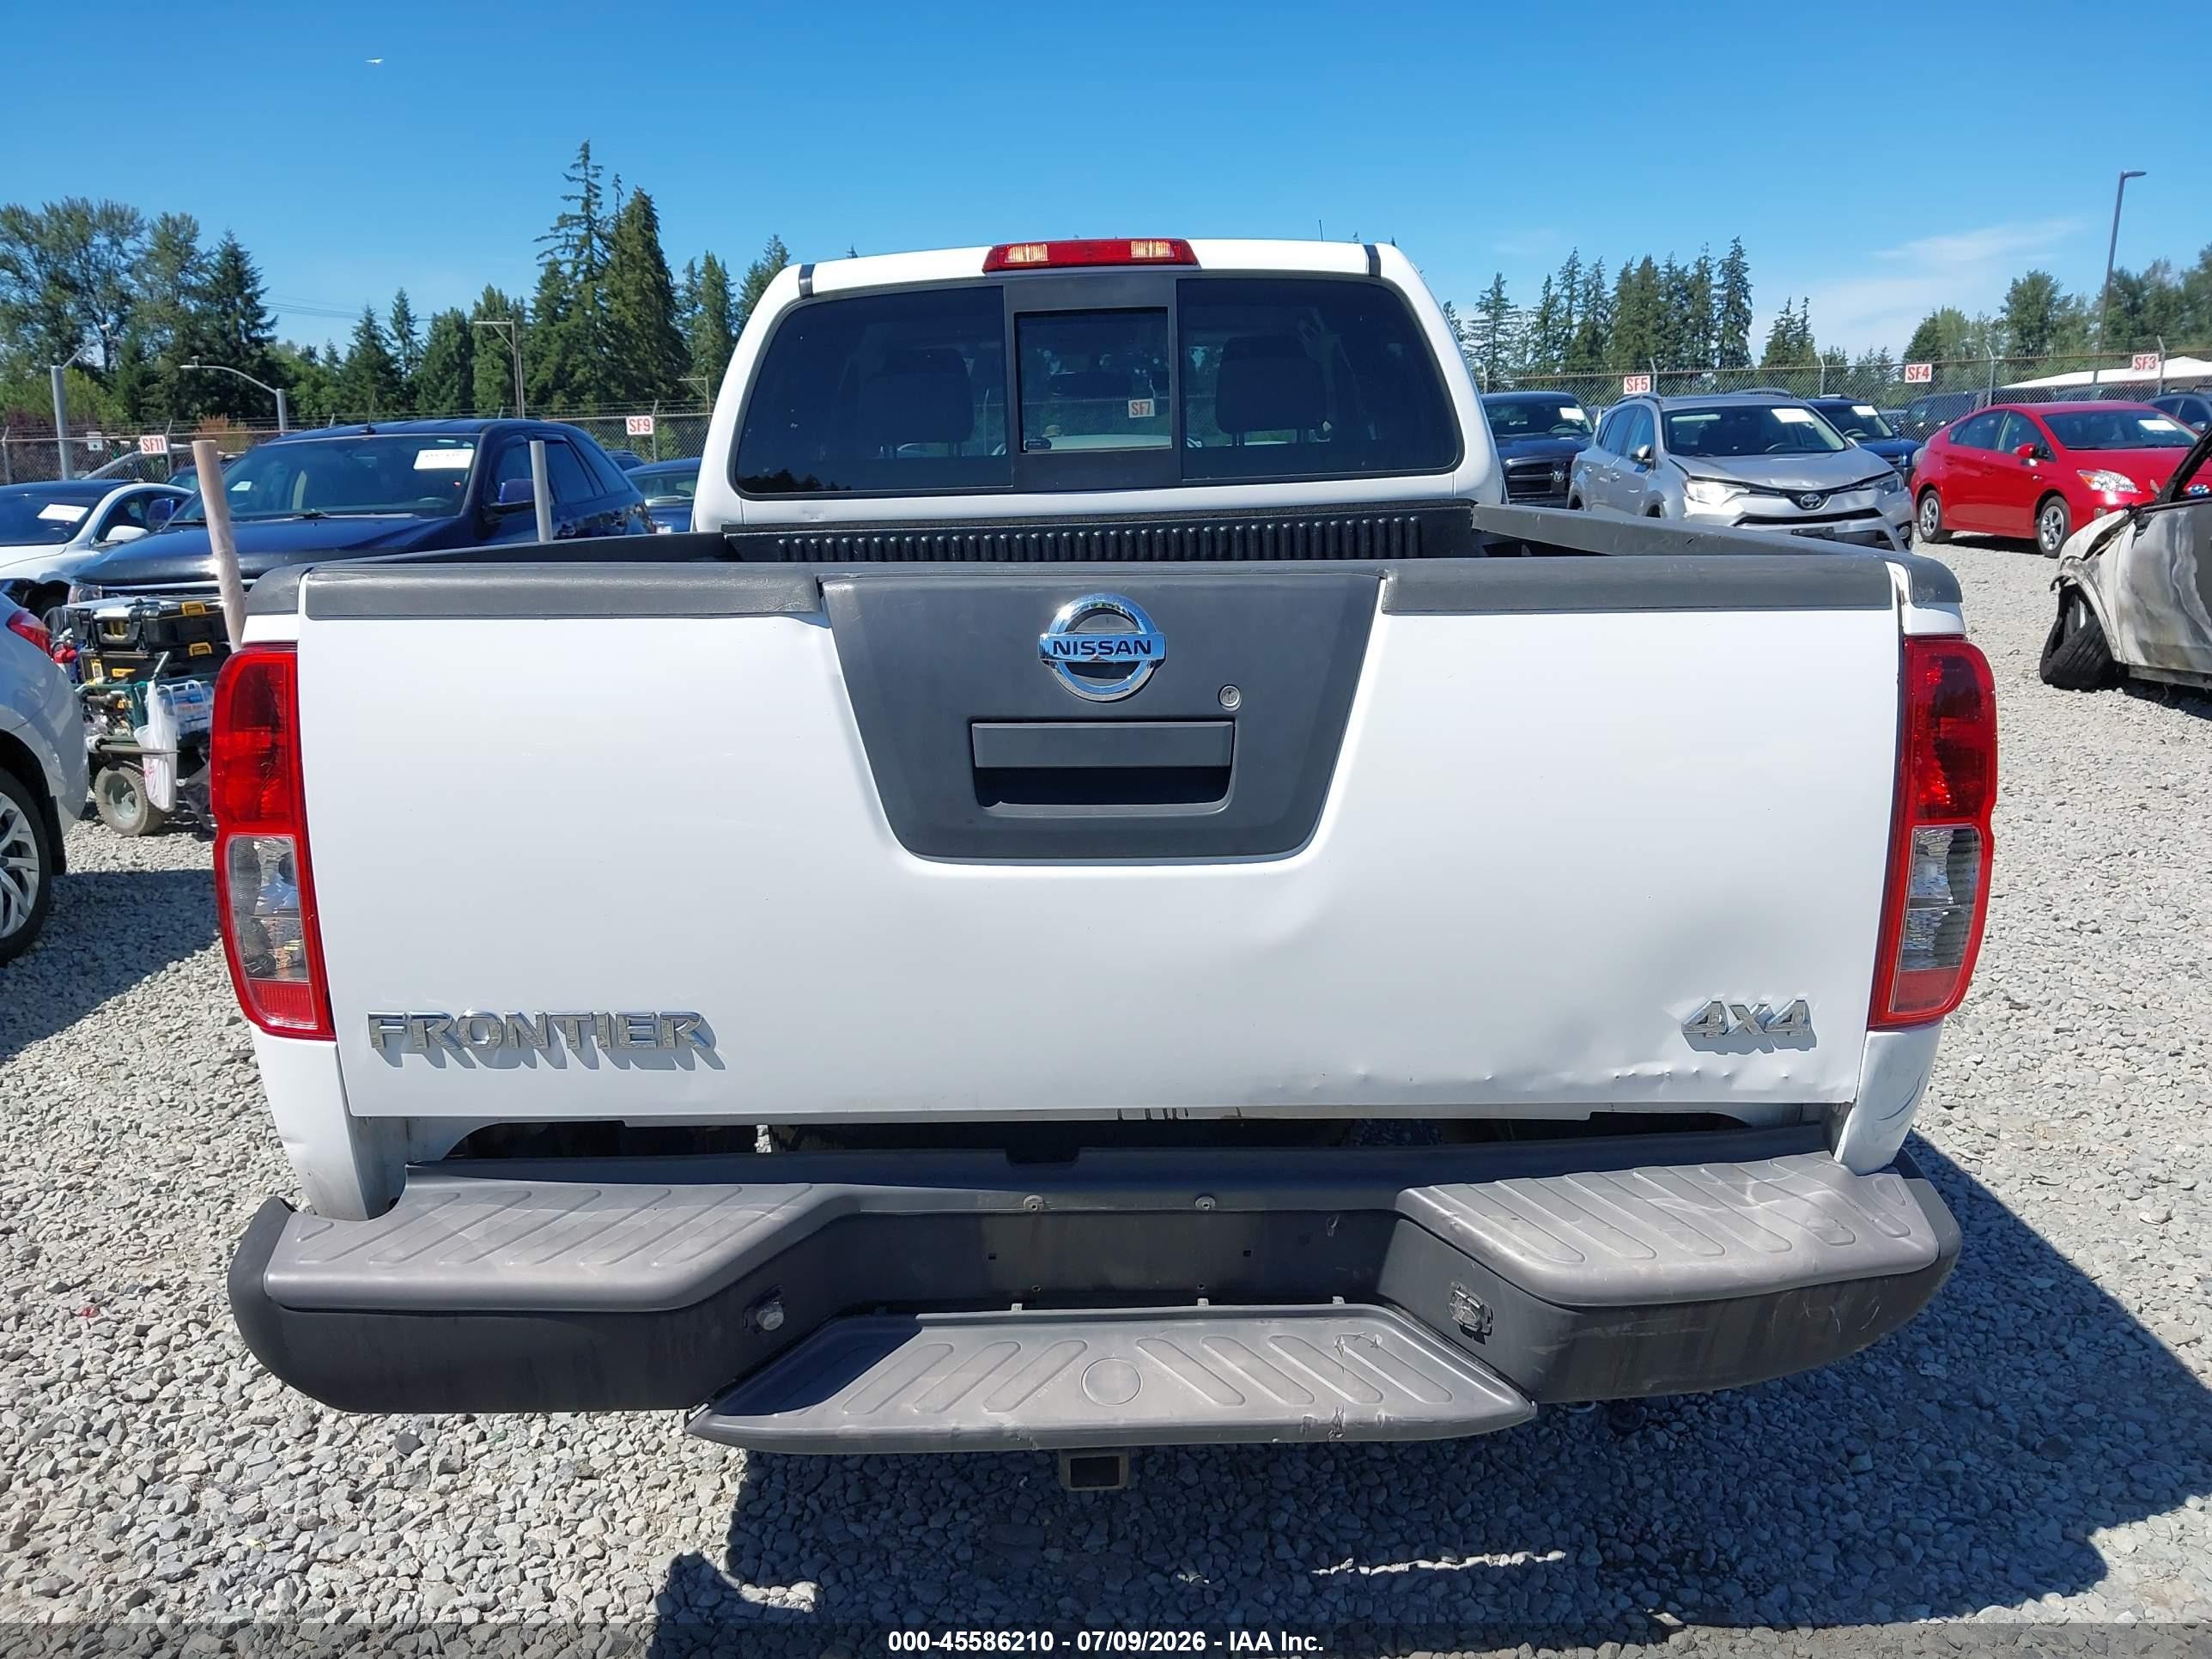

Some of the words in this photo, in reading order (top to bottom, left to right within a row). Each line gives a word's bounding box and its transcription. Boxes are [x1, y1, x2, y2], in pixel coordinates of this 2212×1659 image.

[2135, 356, 2157, 371] SF3
[1908, 366, 1929, 380] SF4
[1626, 377, 1648, 392] SF5
[1132, 401, 1151, 416] SF7
[629, 418, 650, 432] SF9
[143, 437, 165, 452] SF11
[1053, 640, 1152, 655] NISSAN
[367, 1010, 712, 1050] FRONTIER
